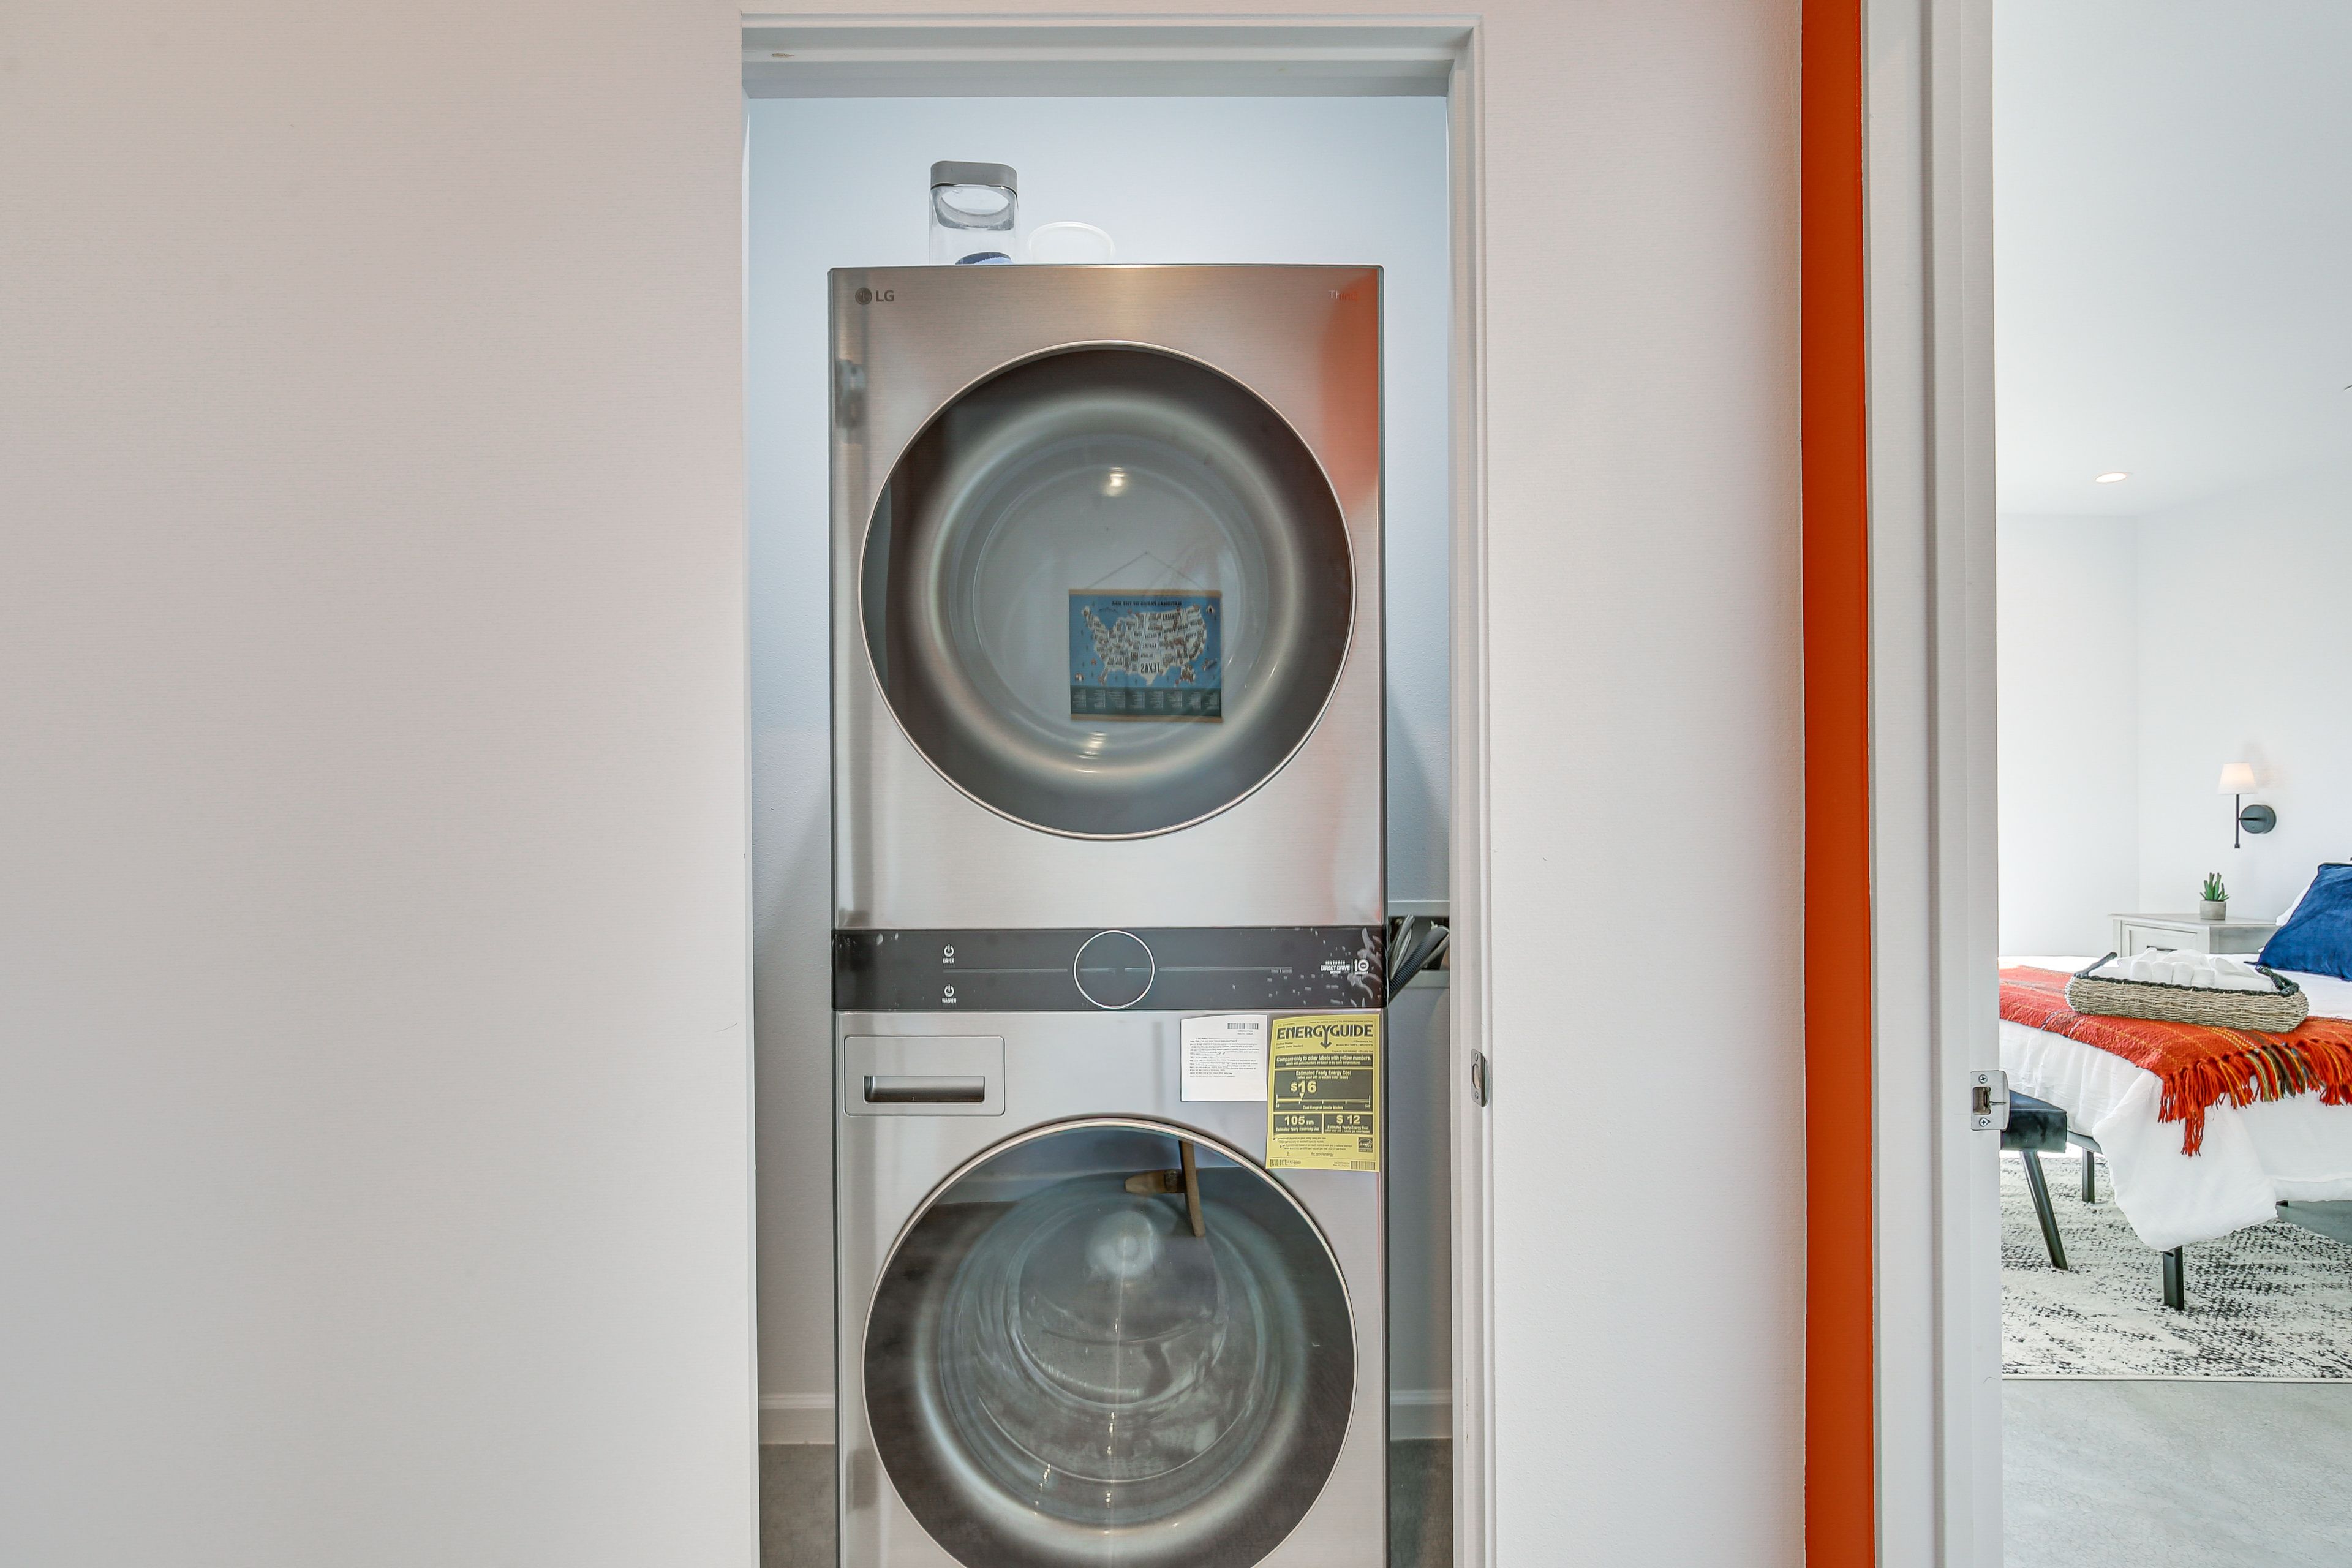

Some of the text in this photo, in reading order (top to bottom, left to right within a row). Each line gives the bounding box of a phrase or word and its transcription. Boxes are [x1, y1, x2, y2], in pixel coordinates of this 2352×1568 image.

[875, 290, 894, 302] LG
[1277, 1024, 1373, 1041] ENERGYGUIDE
[1291, 1080, 1317, 1093] $16
[1284, 1115, 1305, 1126] 105
[1336, 1115, 1360, 1125] $ 12
